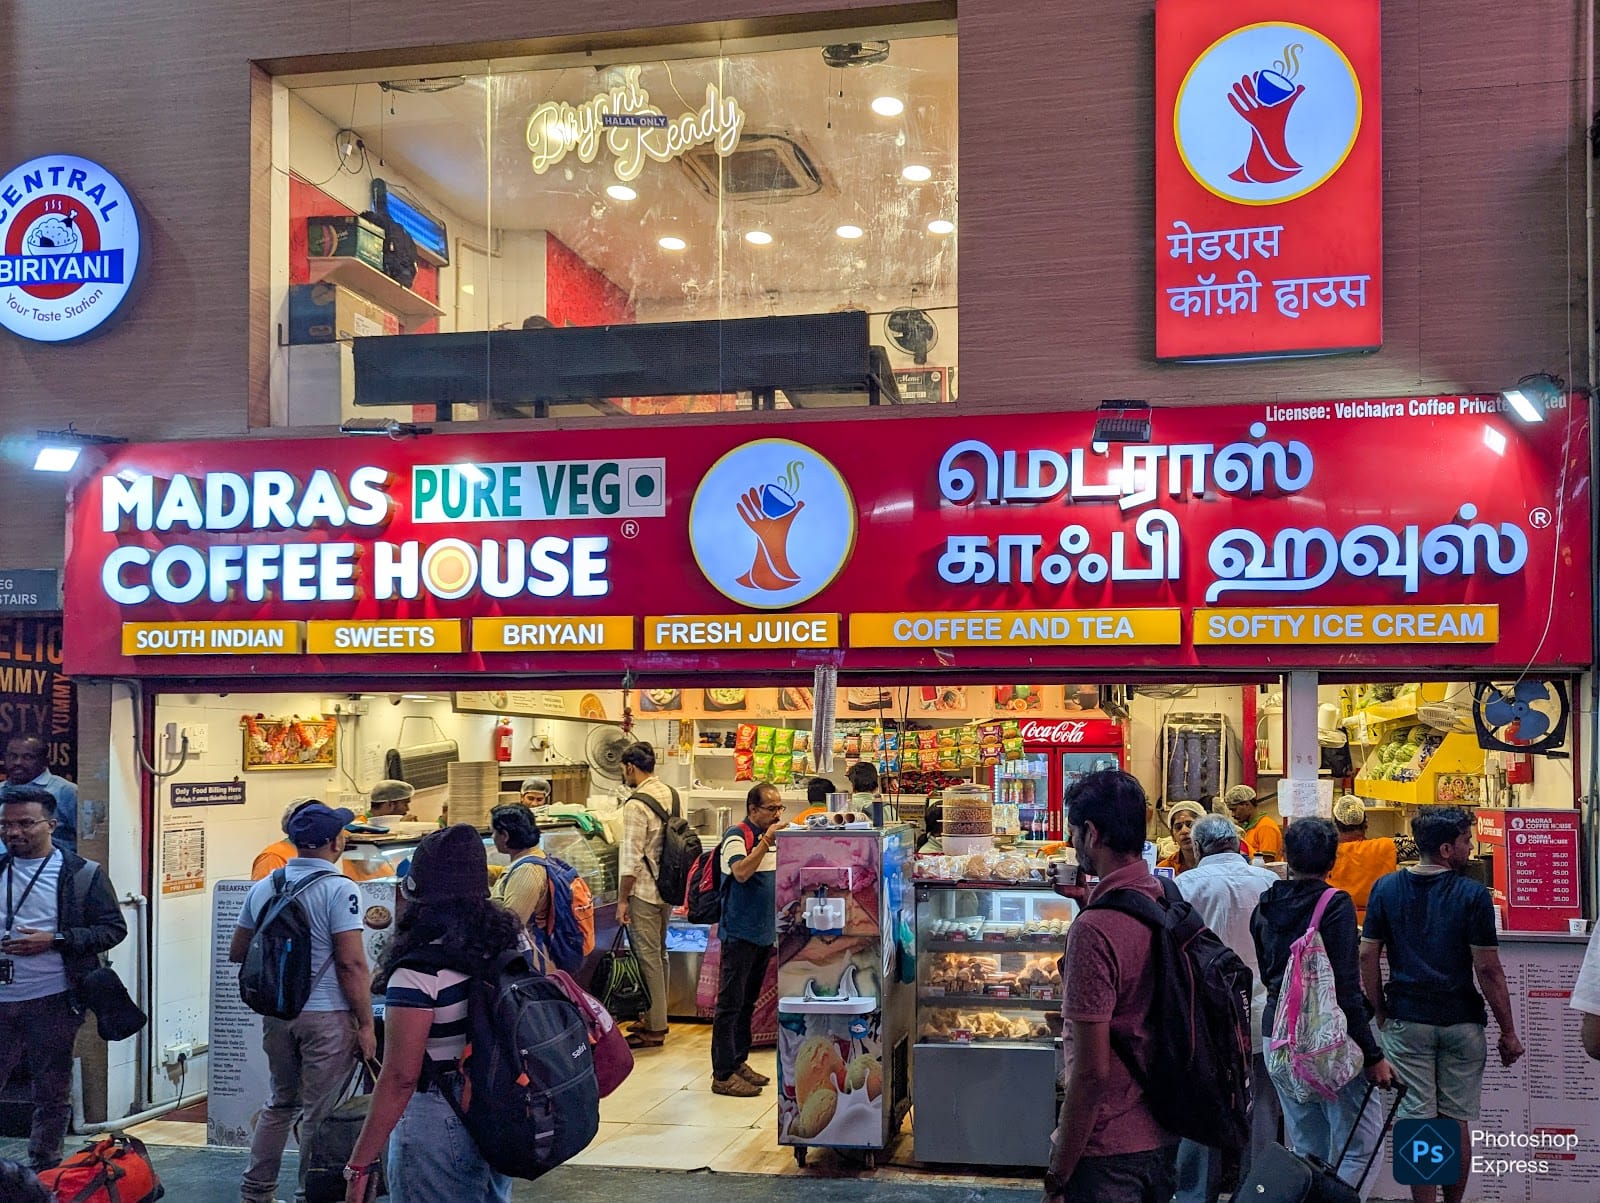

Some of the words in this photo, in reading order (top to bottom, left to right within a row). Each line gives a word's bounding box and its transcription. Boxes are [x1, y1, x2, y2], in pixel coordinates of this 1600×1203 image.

[605, 115, 638, 127] HALAL
[639, 116, 667, 127] ONLY
[1166, 220, 1285, 264] मेडरास
[6, 293, 30, 317] Your
[33, 308, 62, 322] Taste
[64, 288, 104, 319] Station
[1271, 274, 1371, 319] हाउस
[1266, 404, 1331, 422] Licensee:
[1334, 401, 1405, 420] Velchakra
[1408, 398, 1455, 416] Coffee
[938, 421, 1314, 511] மெட்ராஸ்
[102, 465, 389, 532] MADRAS
[414, 465, 522, 519] PURE
[536, 462, 621, 515] VEG
[937, 508, 1180, 585] காஃபி
[1204, 502, 1529, 602] ஹவுஸ்
[102, 542, 356, 604] COFFEE
[374, 535, 609, 600] HOUSE
[136, 629, 205, 649] SOUTH
[211, 629, 284, 648] INDIAN
[334, 626, 436, 648] SWEETS
[503, 623, 604, 646] BRIYANI
[655, 622, 744, 645] FRESH
[747, 620, 828, 644] JUICE
[893, 618, 1003, 641] COFFEE
[1009, 617, 1070, 641] AND
[1077, 616, 1135, 640] TEA
[1208, 614, 1306, 639] SOFTY
[1313, 613, 1364, 638] ICE
[1372, 612, 1485, 637] CREAM
[52, 672, 72, 735] YUMMY
[175, 787, 190, 796] Only
[208, 786, 227, 795] Billing
[349, 894, 359, 914] 3
